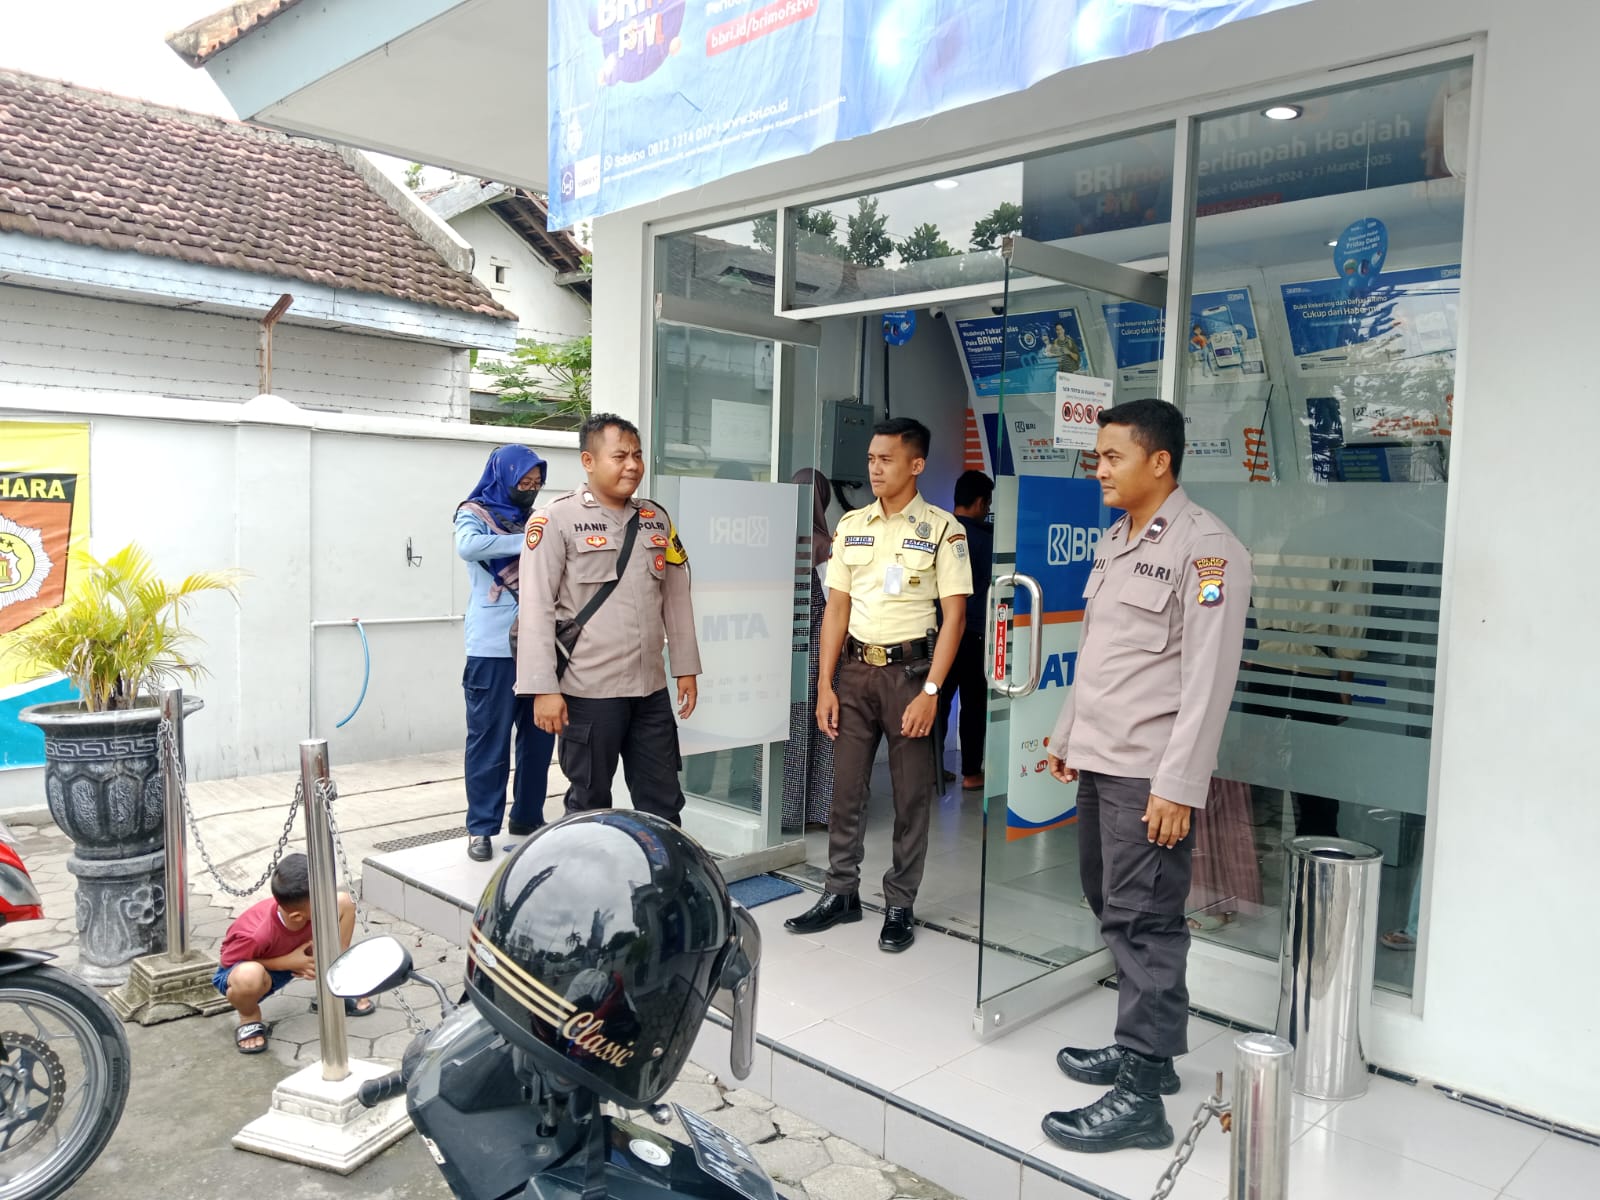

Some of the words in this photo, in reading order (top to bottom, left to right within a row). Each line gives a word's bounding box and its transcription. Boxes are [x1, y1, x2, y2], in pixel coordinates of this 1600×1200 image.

[1198, 136, 1307, 176] erlimpah
[1315, 114, 1412, 154] Hadiah
[1230, 176, 1274, 192] Oktober
[574, 523, 608, 532] HANIF
[637, 522, 665, 532] POLRI
[1072, 527, 1107, 562] BR
[1133, 562, 1171, 581] POLRI
[995, 626, 1006, 678] TARIK
[1038, 652, 1078, 690] AT
[562, 1011, 634, 1068] Classic
